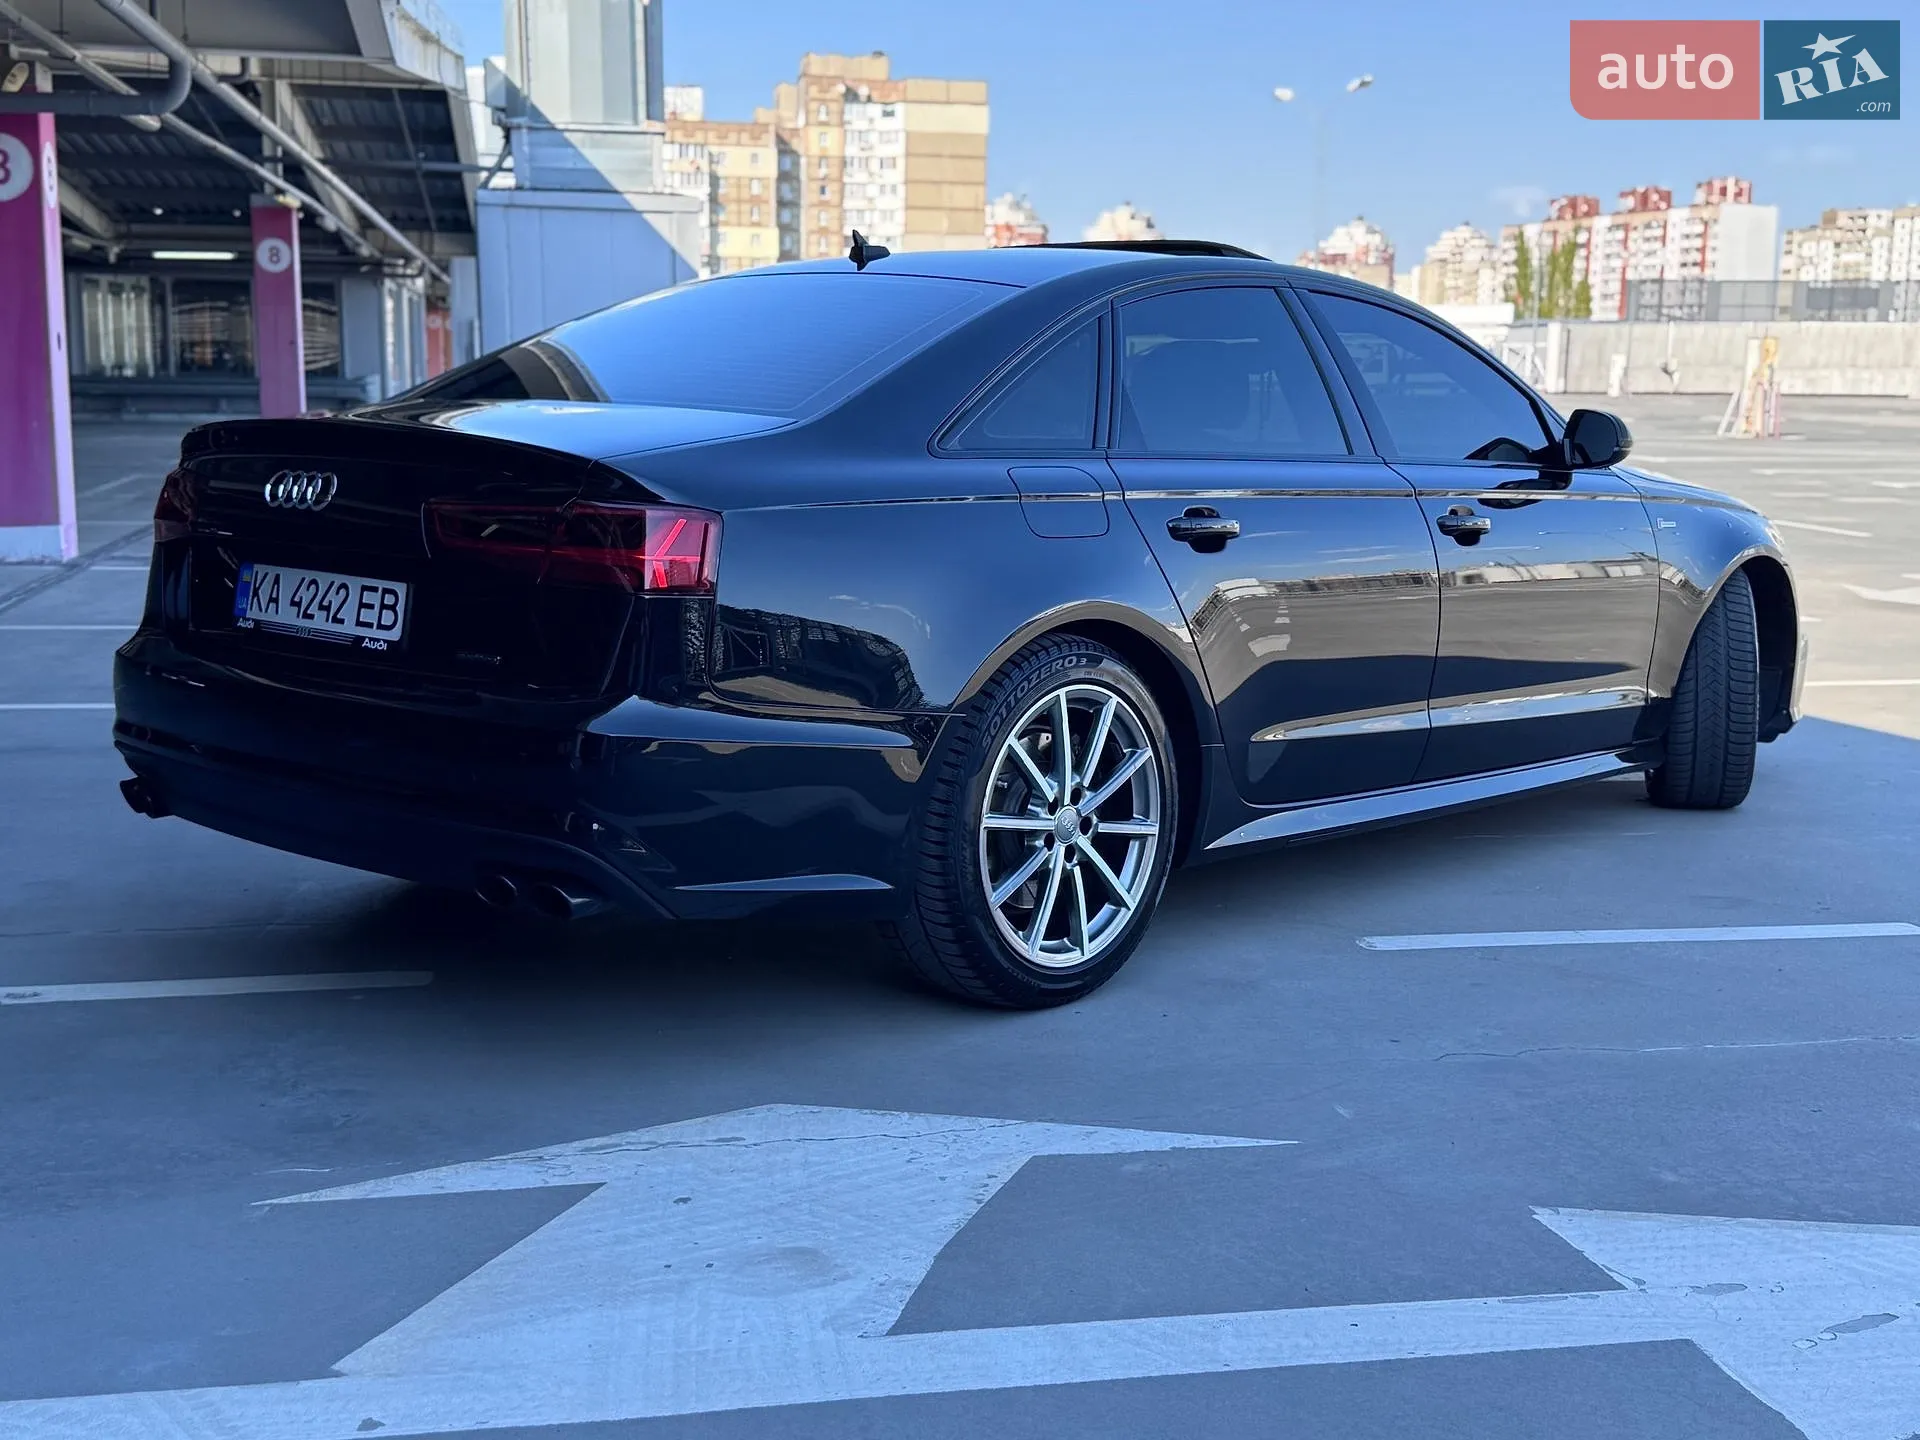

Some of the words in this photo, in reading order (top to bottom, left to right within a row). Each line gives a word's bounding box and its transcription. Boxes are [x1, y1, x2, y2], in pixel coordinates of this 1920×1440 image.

[268, 246, 281, 265] 8
[249, 570, 281, 614] KA
[289, 576, 350, 625] 4242
[355, 584, 400, 632] EB
[236, 617, 255, 629] Audi
[362, 637, 388, 650] Audi
